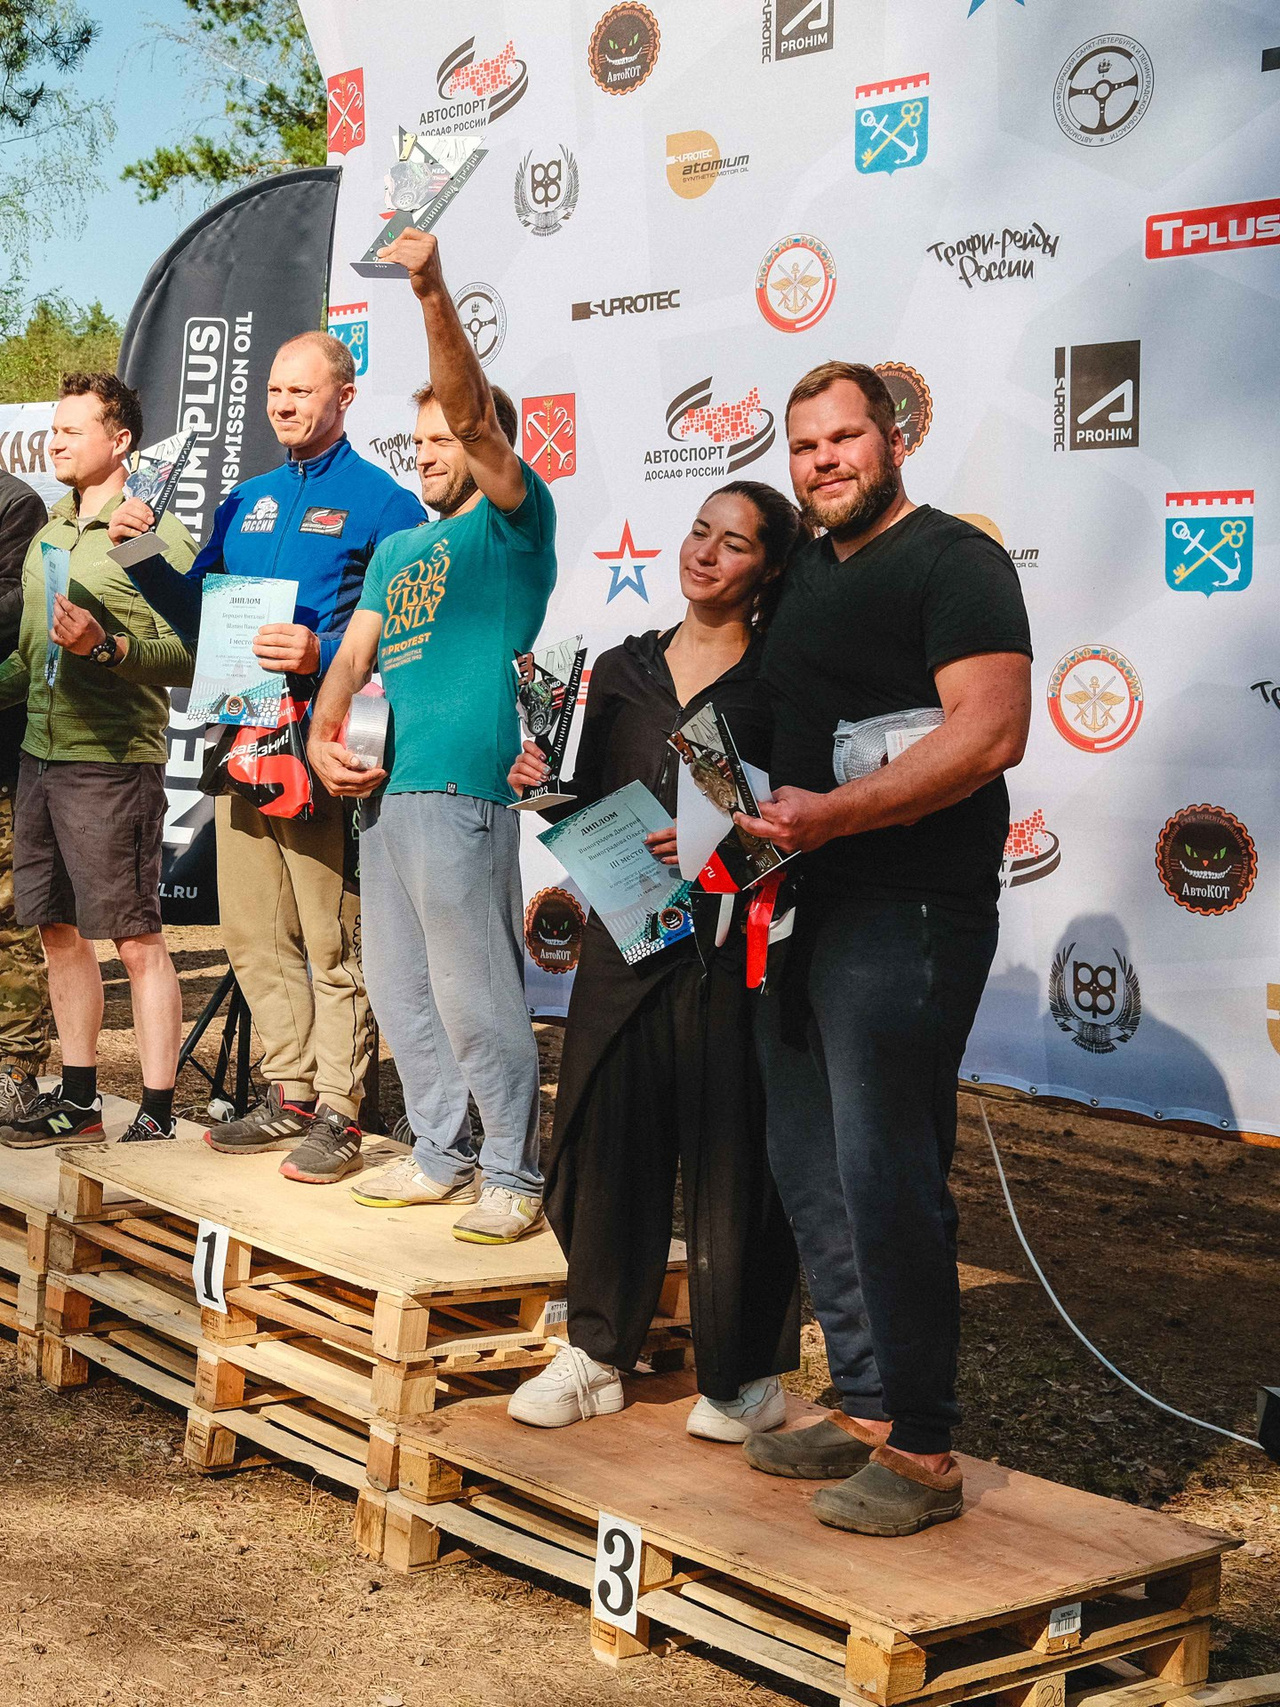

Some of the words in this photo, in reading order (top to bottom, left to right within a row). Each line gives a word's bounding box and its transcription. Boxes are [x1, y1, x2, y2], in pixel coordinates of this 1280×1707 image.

[780, 32, 828, 53] PROHIM
[419, 98, 487, 126] АВТОСПОРТ
[453, 117, 487, 133] РОССИИ
[671, 148, 713, 164] SUPROTEC
[716, 168, 739, 177] MOTOR
[959, 255, 1034, 288] России
[582, 289, 680, 319] SUPROTEC
[233, 311, 253, 352] OIL
[182, 325, 221, 433] PLUS
[1053, 377, 1066, 452] SUPROTEC
[1076, 427, 1133, 443] PROHIM
[643, 445, 724, 464] АВТОСПОРТ
[644, 469, 683, 482] ДОСААФ
[685, 466, 725, 478] РОССИИ
[240, 519, 274, 533] РОССИИ
[387, 556, 451, 595] GOOD
[229, 597, 261, 605] ДИПЛОМ
[385, 576, 447, 616] VIBES
[383, 599, 441, 639] ONLY
[387, 632, 432, 655] PROTEST
[1049, 648, 1092, 693] ДОСААФ
[1100, 647, 1142, 698] РОССИИ
[578, 833, 614, 854] Виноградов
[613, 818, 642, 836] Дмитрий
[580, 811, 619, 836] ДИПЛОМ
[588, 839, 627, 861] Виноградова
[626, 828, 645, 840] Ольга
[609, 860, 621, 870] III
[620, 848, 644, 864] место
[1182, 882, 1230, 900] АвтоКОТ
[540, 948, 572, 961] АвтоКОТ
[202, 1231, 220, 1304] 1
[597, 1527, 635, 1617] 3
